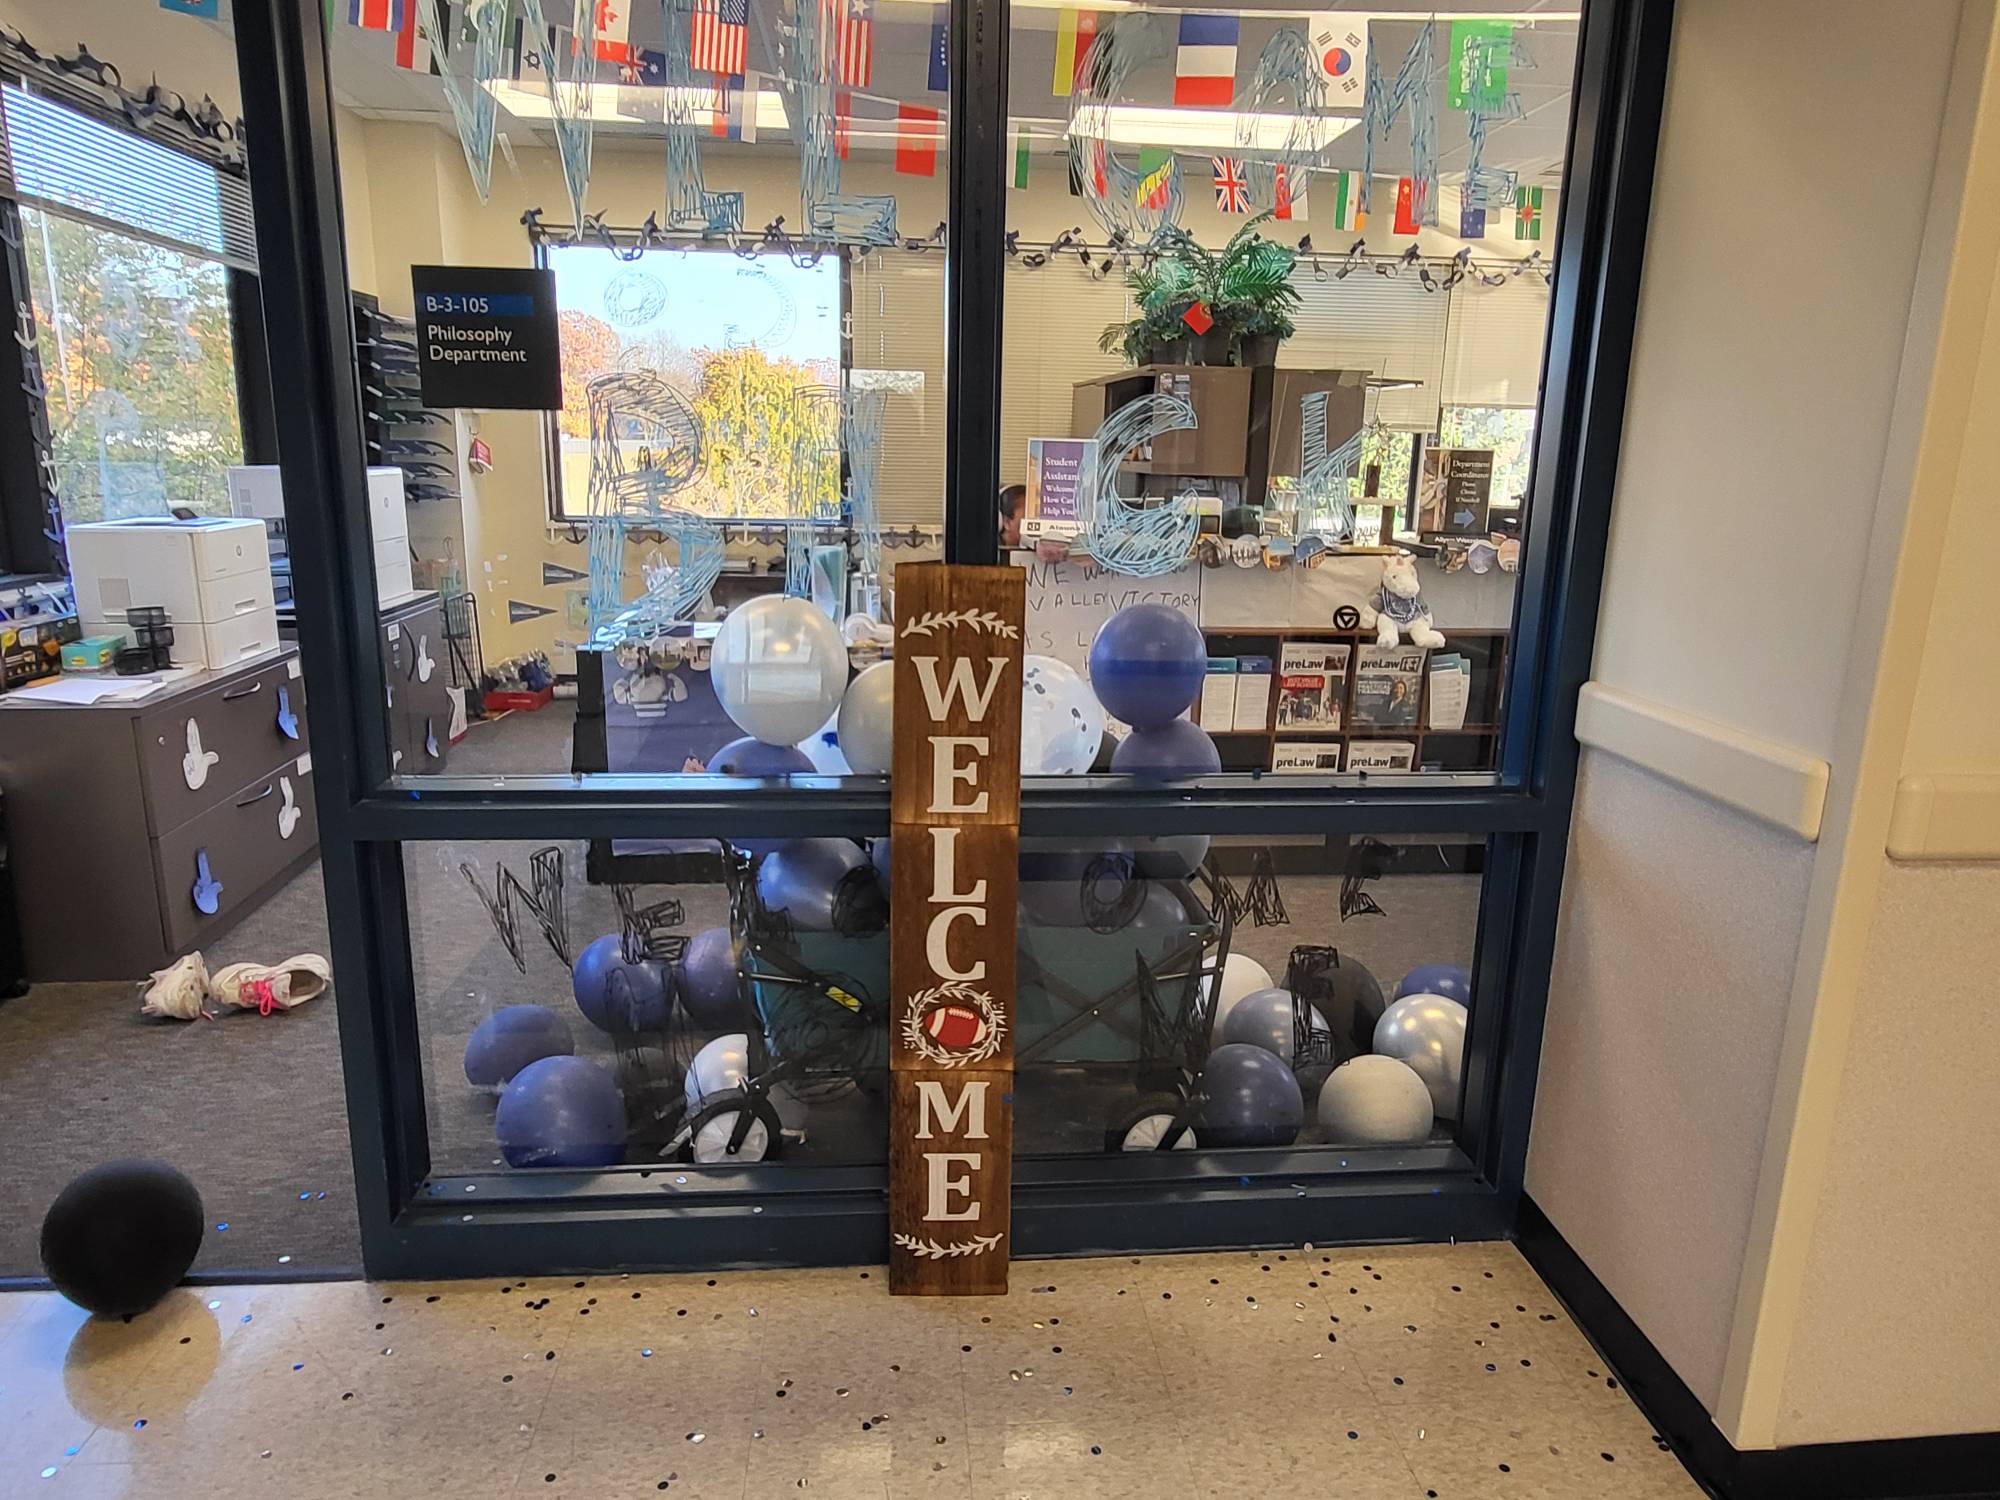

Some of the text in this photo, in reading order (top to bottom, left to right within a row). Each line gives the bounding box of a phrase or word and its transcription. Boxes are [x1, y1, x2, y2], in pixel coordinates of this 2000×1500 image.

[426, 296, 489, 313] B-3-105
[427, 325, 513, 346] Philosophy
[429, 345, 528, 366] Department
[1045, 457, 1078, 467] Student
[1283, 659, 1323, 671] preLaw
[1360, 659, 1400, 671] preLaw
[1276, 757, 1315, 769] preLaw
[1350, 757, 1389, 769] preLaw
